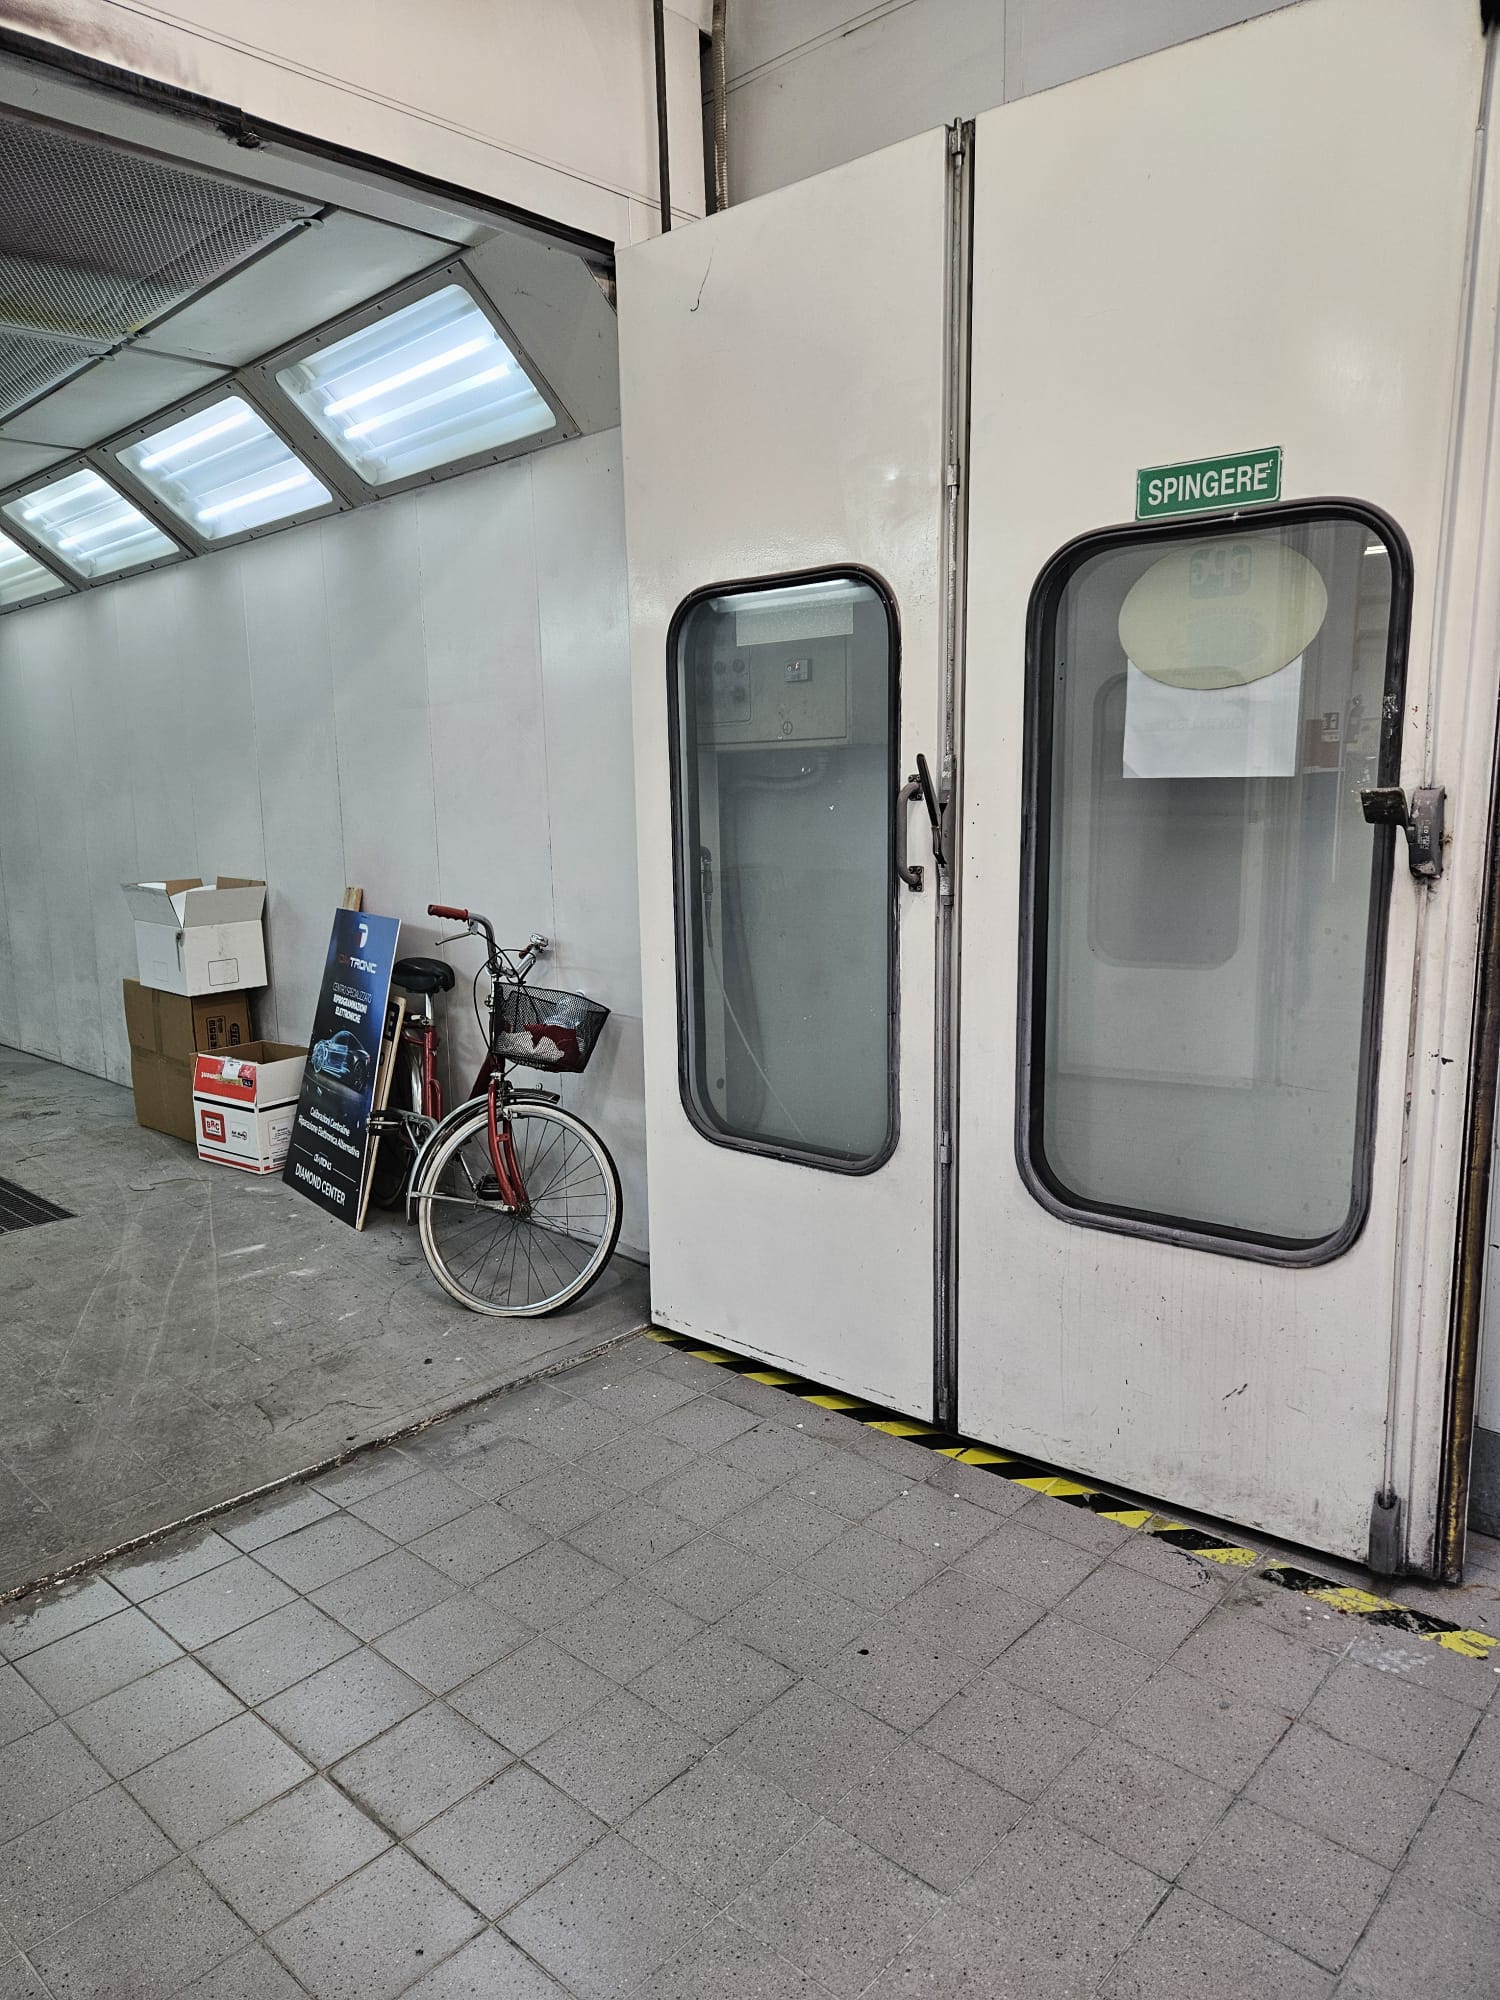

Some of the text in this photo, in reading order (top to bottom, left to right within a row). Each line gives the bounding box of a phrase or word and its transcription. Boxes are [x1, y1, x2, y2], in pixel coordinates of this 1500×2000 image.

[1147, 462, 1270, 506] SPINGERE
[295, 1163, 346, 1206] DIAMOND CENTER
